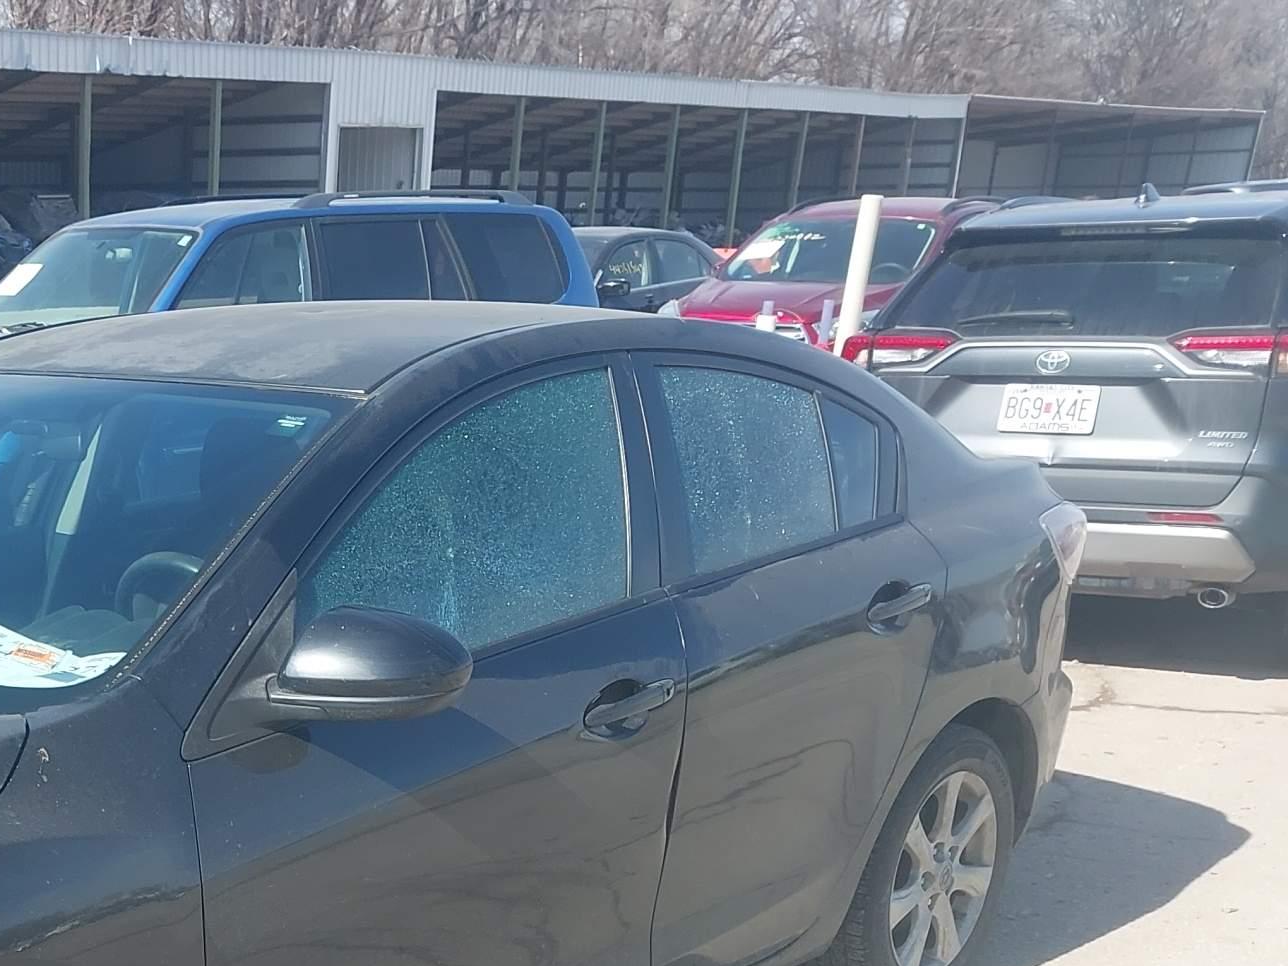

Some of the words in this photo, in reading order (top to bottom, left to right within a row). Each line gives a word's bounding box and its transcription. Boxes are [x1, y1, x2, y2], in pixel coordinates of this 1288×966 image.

[1004, 396, 1044, 420] BG9
[1051, 398, 1093, 422] X4E
[1198, 430, 1249, 439] LIMITED
